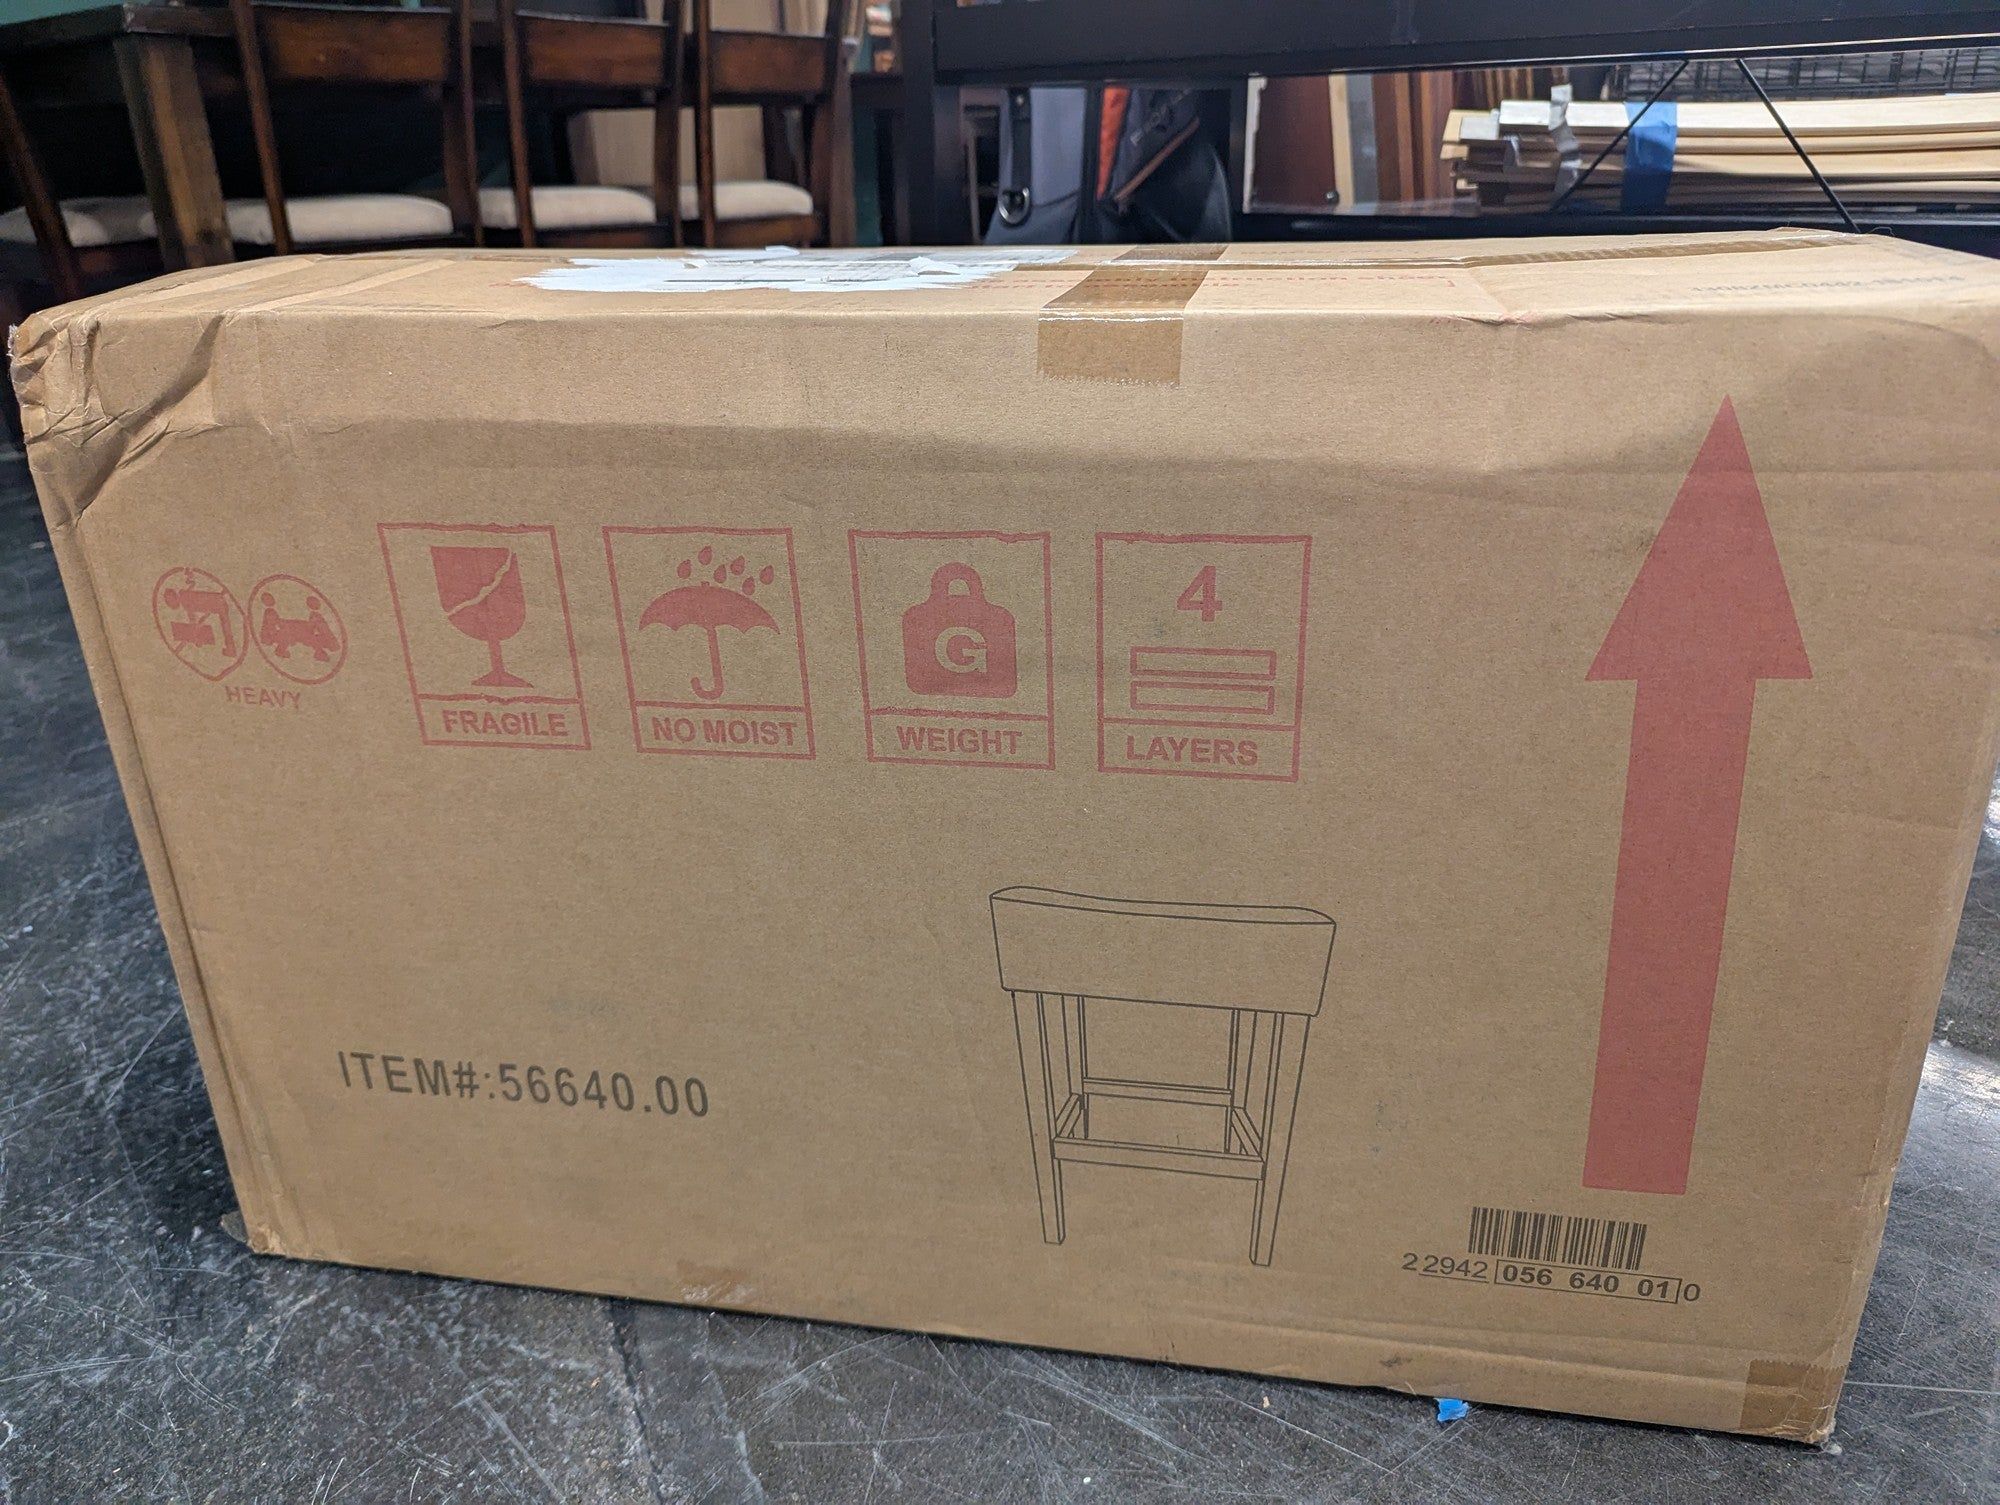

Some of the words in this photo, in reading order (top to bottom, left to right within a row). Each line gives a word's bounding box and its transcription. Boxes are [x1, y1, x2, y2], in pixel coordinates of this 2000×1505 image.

[1176, 564, 1223, 622] 4
[934, 626, 988, 674] G
[224, 685, 301, 709] HEAVY
[441, 709, 569, 737] FRAGILE
[652, 716, 697, 742] NO
[702, 719, 798, 746] MOIST
[896, 725, 1023, 756] WEIGHT
[1126, 735, 1258, 766] LAYERS
[337, 1050, 710, 1118] ITEM#:56640.00
[1502, 1264, 1553, 1286] 056
[1568, 1271, 1620, 1294] 640
